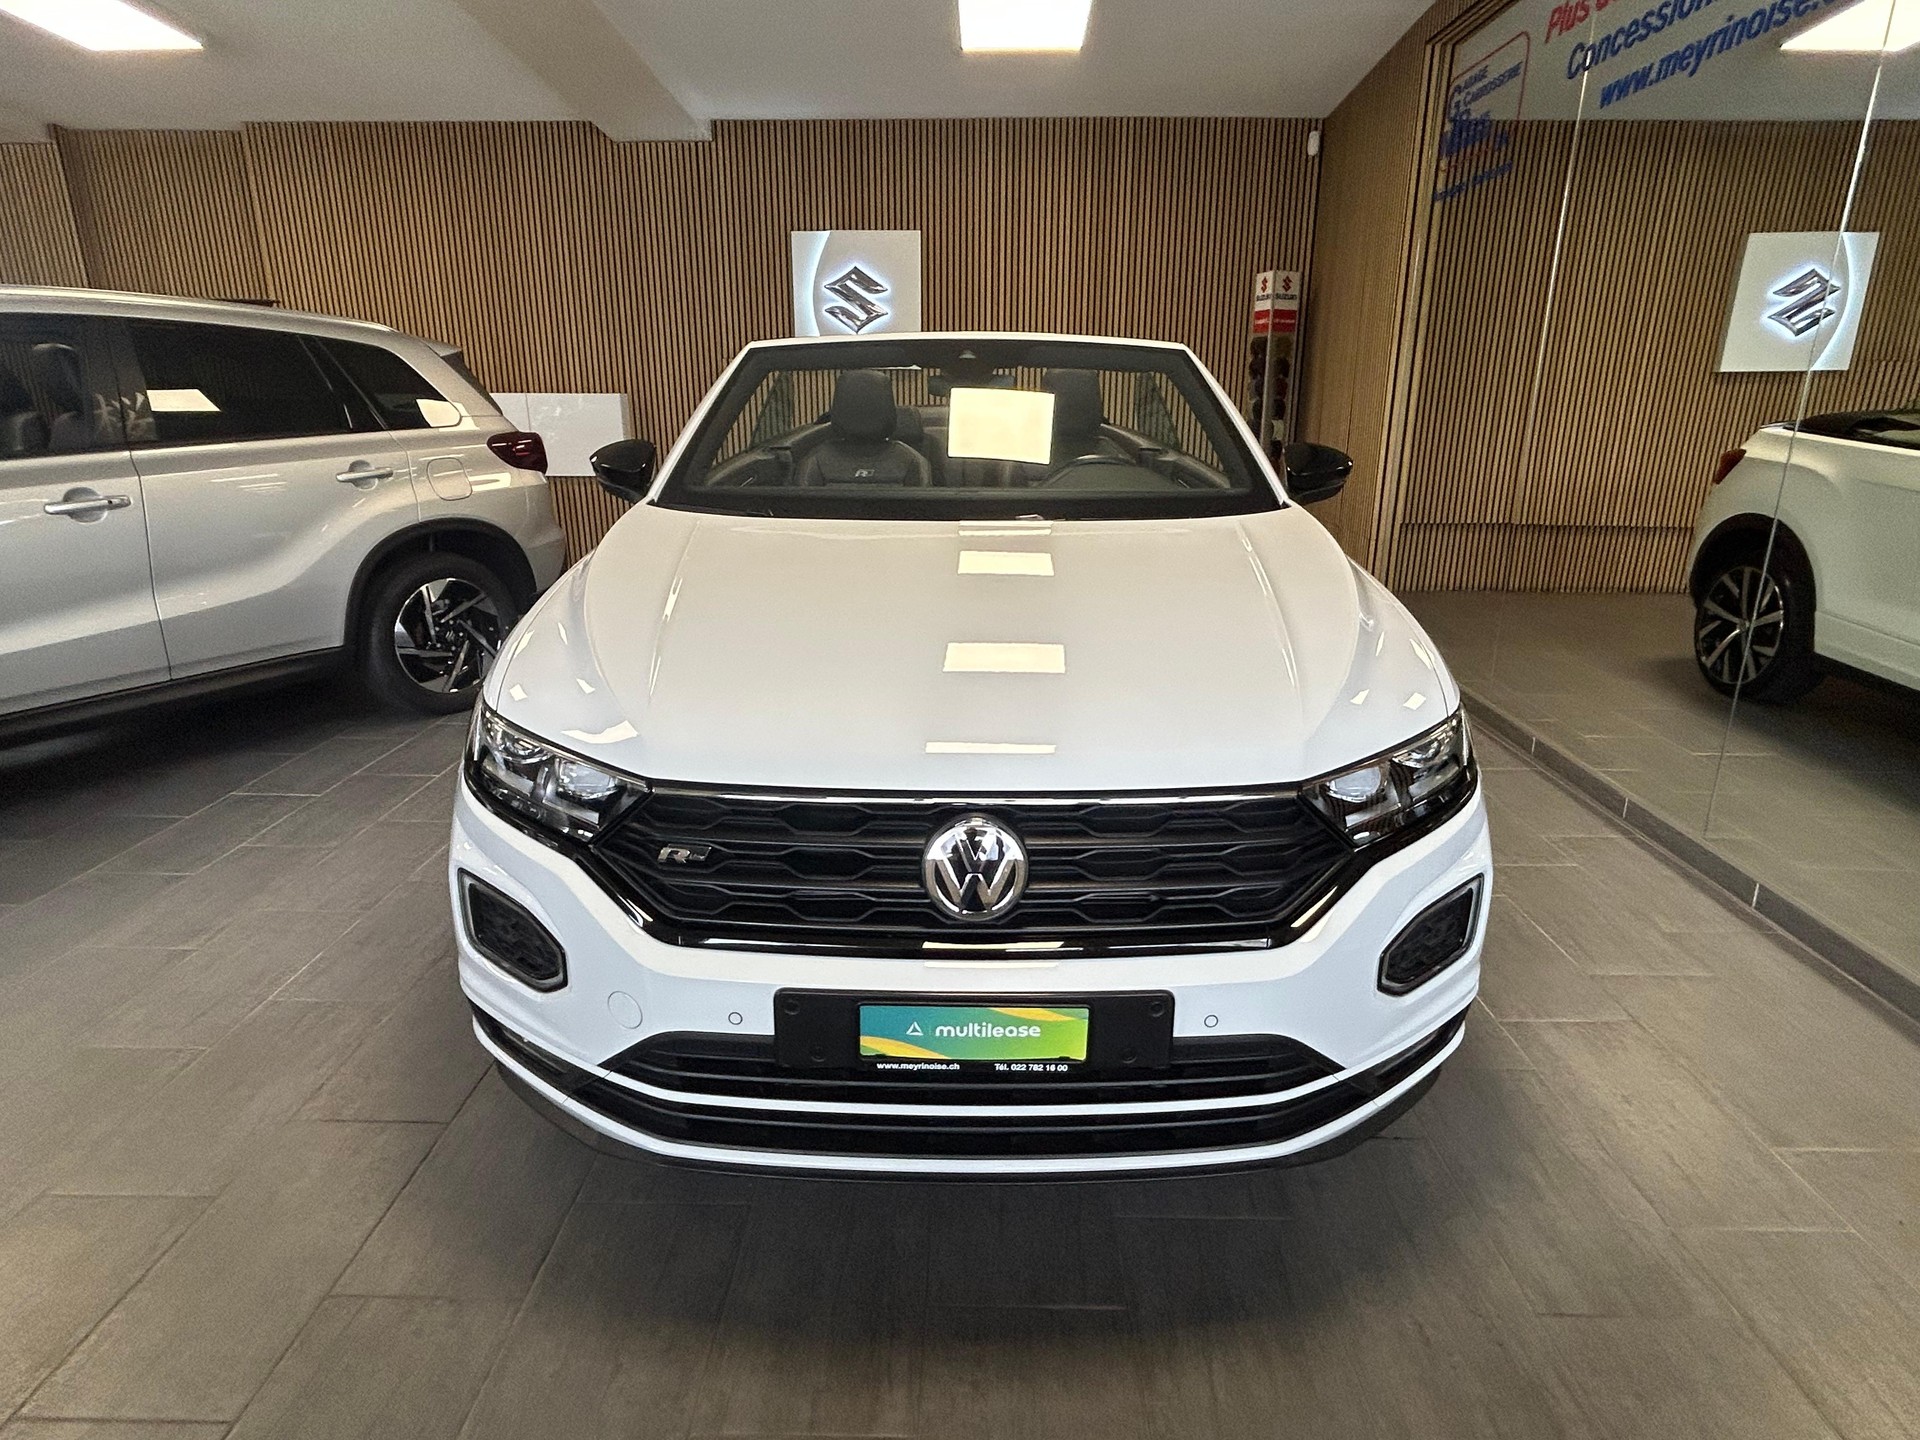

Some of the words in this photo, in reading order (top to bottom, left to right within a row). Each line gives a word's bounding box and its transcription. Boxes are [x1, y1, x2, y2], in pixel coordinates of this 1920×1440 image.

[935, 1022, 1041, 1037] multilease
[876, 1062, 961, 1071] www.meyrinoise.ch
[1010, 1063, 1027, 1071] 022
[1057, 1064, 1069, 1072] 00
